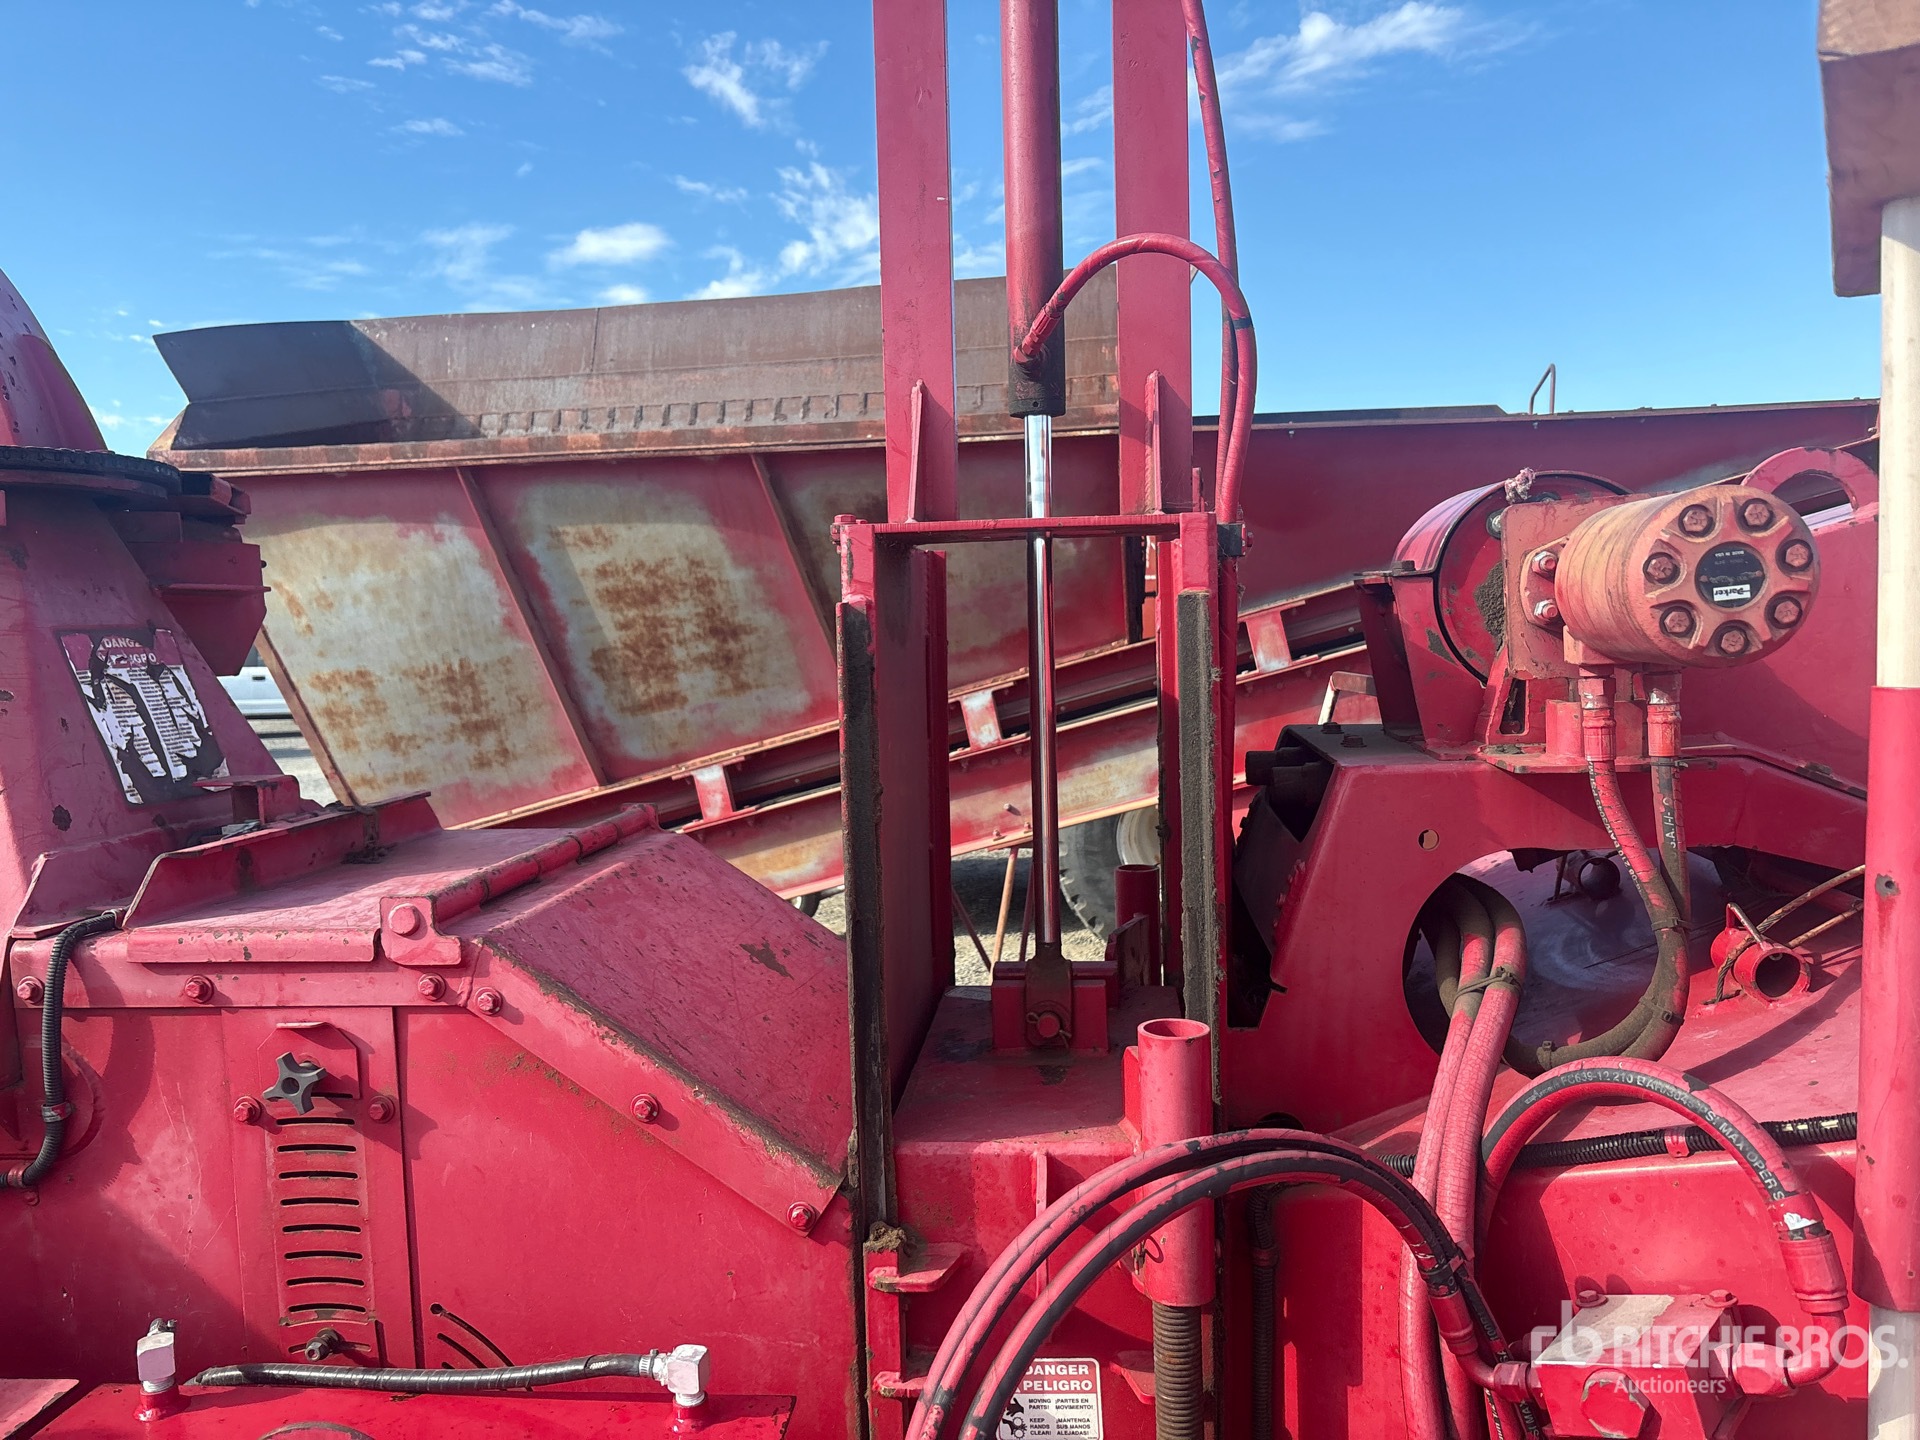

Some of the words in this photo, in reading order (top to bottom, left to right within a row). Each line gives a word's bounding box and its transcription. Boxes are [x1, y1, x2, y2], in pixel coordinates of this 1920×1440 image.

[1714, 588, 1744, 596] Parker
[1618, 850, 1631, 867] 210
[1612, 1070, 1634, 1084] 210
[1718, 1121, 1745, 1151] MAX
[1026, 1364, 1089, 1376] DANGER
[1023, 1380, 1093, 1391] PELIGRO
